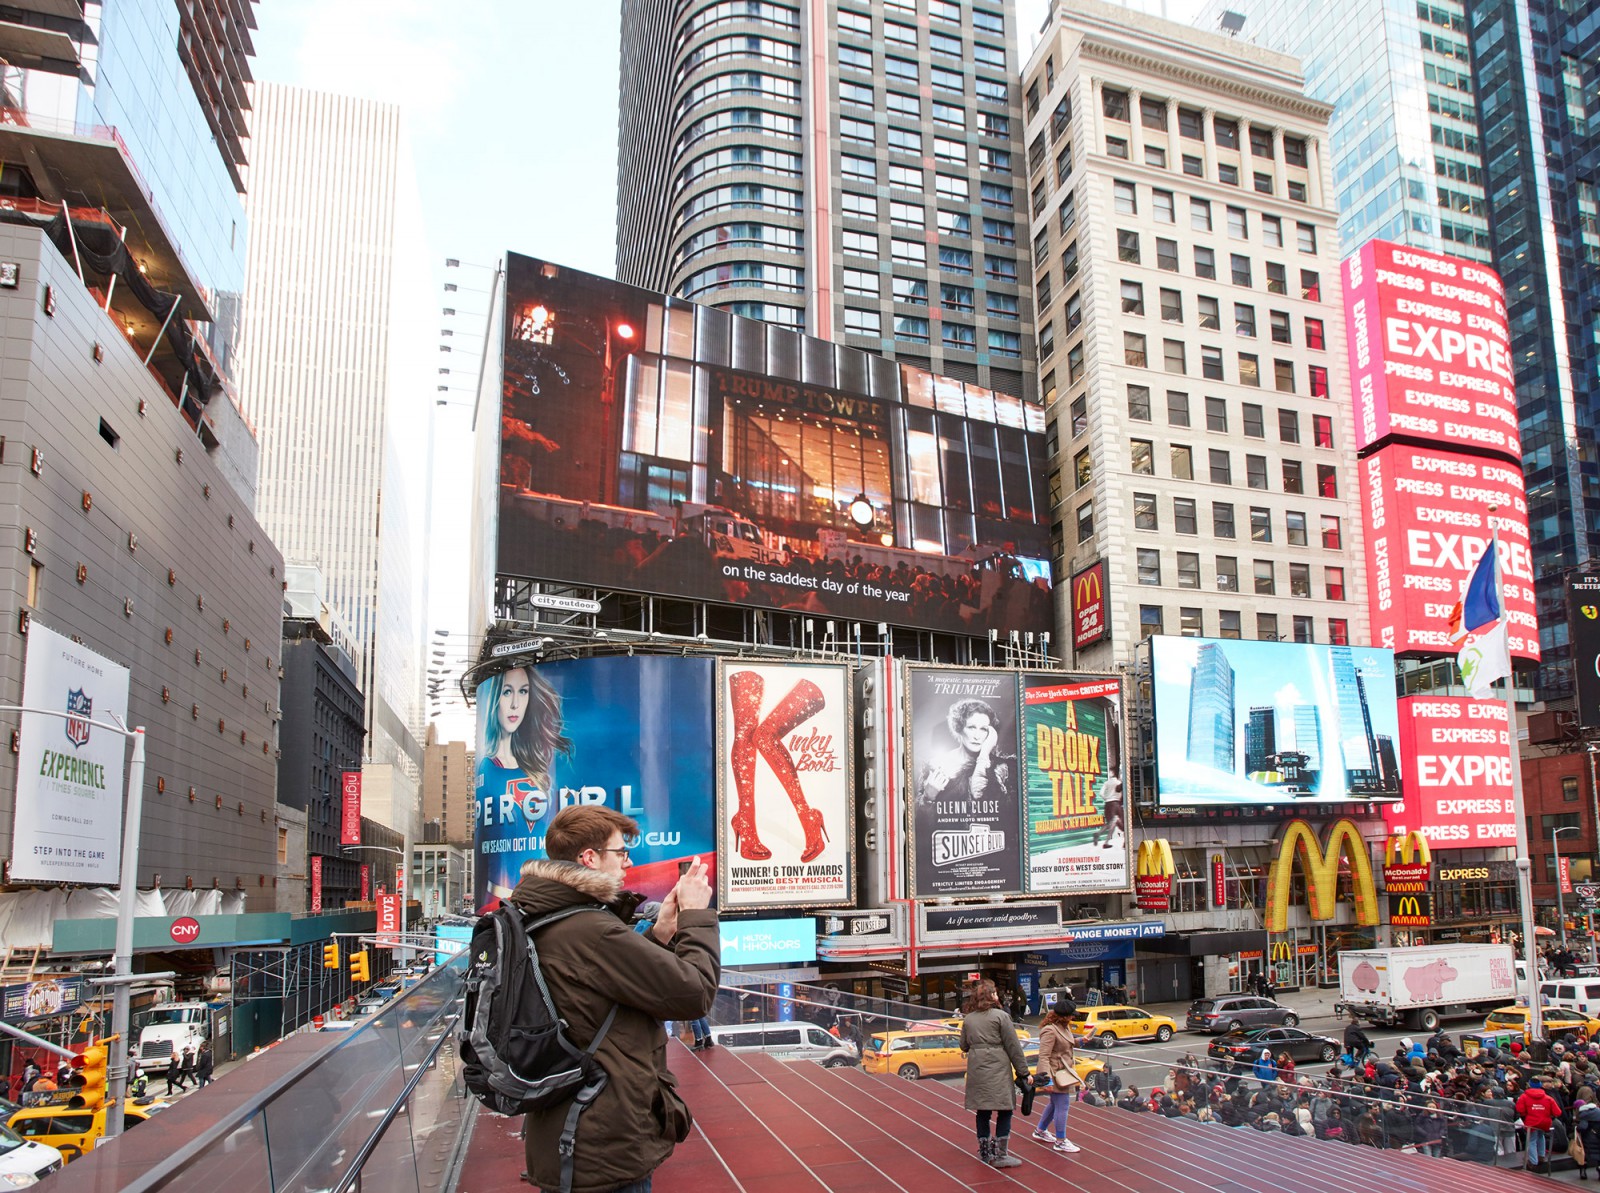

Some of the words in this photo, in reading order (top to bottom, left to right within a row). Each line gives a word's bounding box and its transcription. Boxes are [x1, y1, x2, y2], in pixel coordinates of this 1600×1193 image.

[1391, 250, 1456, 277] EXPRESS
[1430, 281, 1491, 309] EXPRESS
[1396, 298, 1461, 324] EXPRESS
[1353, 298, 1371, 369] EXPRESS
[715, 372, 799, 404] TRUMP
[1439, 371, 1500, 396] EXPRESS
[1360, 373, 1378, 445] EXPRESS
[1405, 389, 1471, 414] EXPRESS
[1444, 421, 1505, 446] EXPRESS
[1411, 455, 1476, 478] EXPRESS
[1368, 455, 1386, 530] EXPRESS
[1450, 485, 1511, 507] EXPRESS
[1416, 507, 1481, 528] EXPRESS
[722, 564, 740, 576] on
[744, 566, 766, 581] the
[769, 572, 818, 589] saddest
[821, 578, 843, 594] day
[847, 582, 859, 594] of
[862, 584, 882, 598] the
[885, 588, 911, 602] year
[1374, 536, 1392, 612] EXPRESS
[537, 597, 557, 606] city
[559, 599, 596, 610] outdoor
[1079, 602, 1100, 619] OPEN
[1082, 613, 1098, 632] 24
[1077, 624, 1103, 643] HOURS
[496, 644, 511, 653] city
[512, 640, 540, 651] outdoor
[62, 651, 85, 669] FUTURE
[87, 665, 104, 677] HOME
[1025, 691, 1036, 700] The
[1036, 690, 1048, 699] New
[1049, 689, 1063, 699] York
[1062, 688, 1080, 696] Times
[1105, 682, 1119, 691] PICK
[1065, 699, 1079, 731] A
[1431, 728, 1496, 744] EXPRESS
[1037, 723, 1102, 775] BRONX
[40, 749, 106, 790] EXPERIENCE
[796, 753, 842, 773] Boots
[51, 781, 72, 795] TIMES
[1048, 770, 1097, 817] TALE
[936, 801, 967, 814] GLENN
[972, 800, 1000, 814] CLOSE
[1437, 799, 1501, 815] EXPRESS
[52, 813, 71, 823] COMING
[71, 815, 82, 824] FALL
[33, 846, 53, 855] STEP
[55, 847, 72, 857] INTO
[74, 849, 86, 858] THE
[88, 850, 105, 860] GAME
[490, 838, 512, 853] SEASON
[512, 837, 527, 852] OCT
[941, 835, 985, 861] SUNSET
[731, 866, 771, 879] WINNER!
[773, 866, 779, 878] 6
[781, 865, 805, 877] TONY
[807, 864, 843, 877] AWARDS
[1031, 866, 1053, 874] JERSEY
[1053, 865, 1070, 873] BOYS
[1070, 864, 1075, 872] &
[1075, 864, 1092, 872] WEST
[1092, 863, 1105, 871] SIDE
[1384, 867, 1428, 876] McDonald's
[1439, 867, 1489, 881] EXPRESS
[1560, 858, 1568, 881] LOVE
[731, 878, 774, 886] INCLUDING
[775, 877, 800, 885] BEST
[801, 876, 844, 884] MUSICAL
[1136, 880, 1169, 889] McDonald's
[383, 896, 395, 930] LOVE
[946, 916, 957, 926] As
[956, 915, 964, 927] if
[974, 916, 993, 924] never
[993, 914, 1008, 922] said
[1008, 911, 1039, 926] goodbye.
[171, 925, 199, 936] CNY
[742, 933, 772, 941] HILTON
[854, 920, 877, 935] SUNSET
[1103, 927, 1140, 938] MONEY
[1143, 925, 1164, 935] ATM
[742, 939, 801, 951] HHONORS
